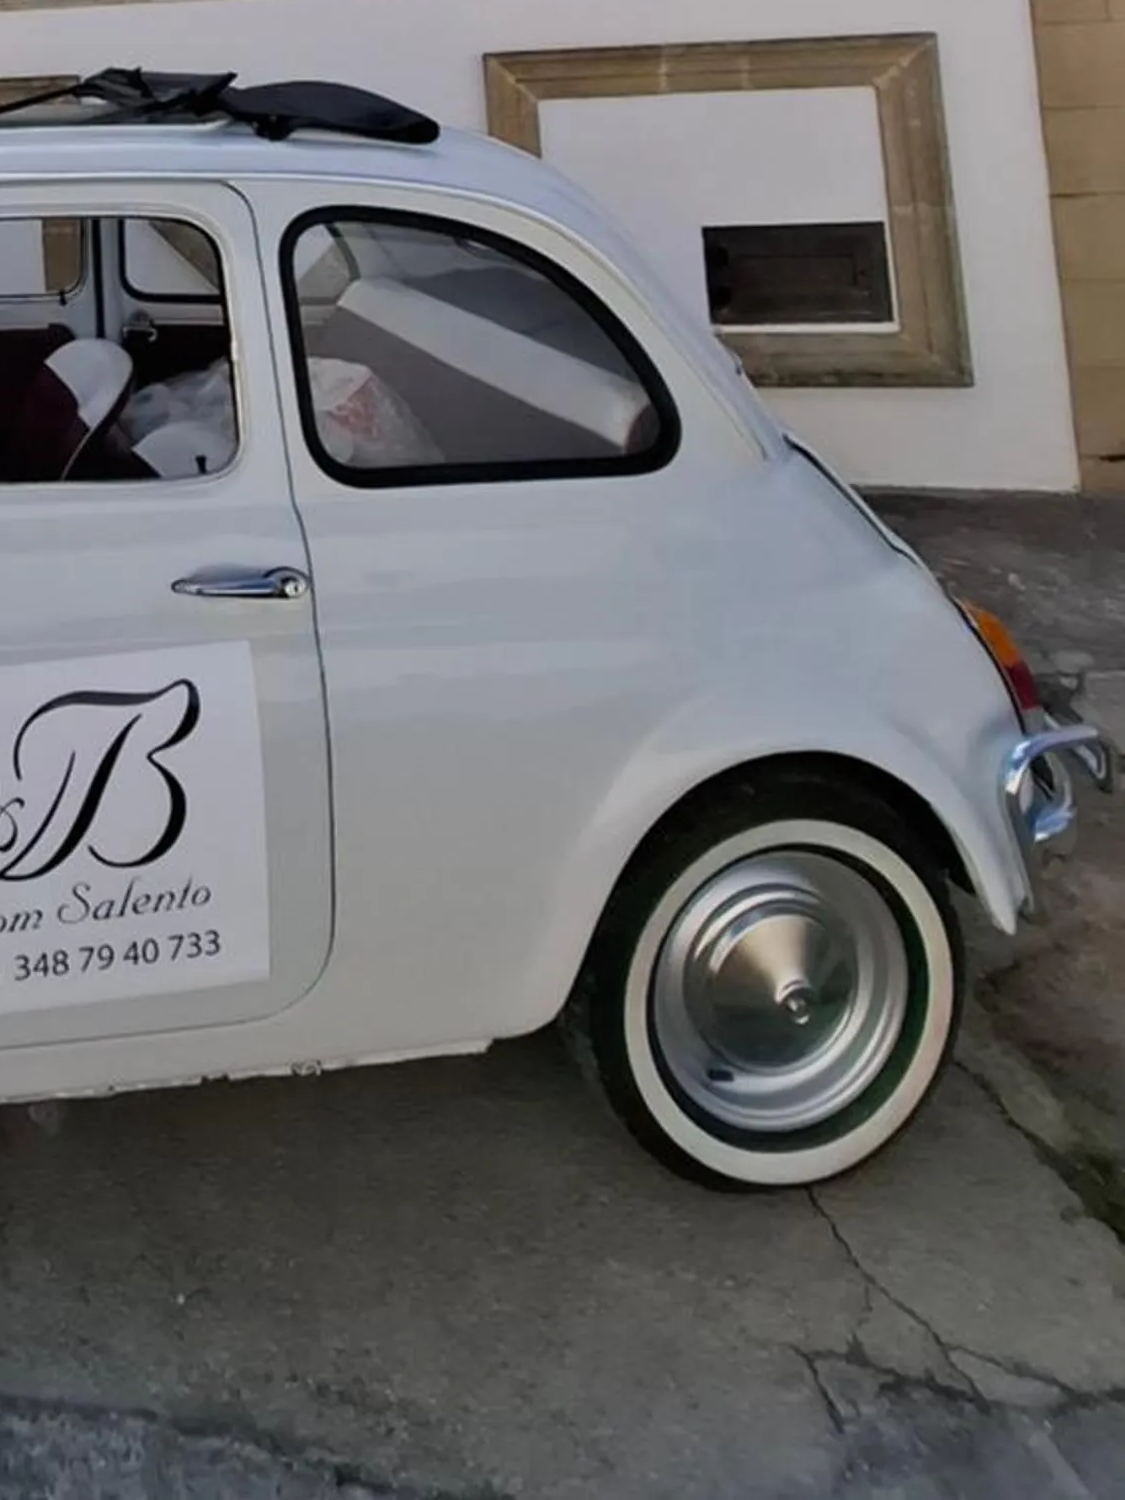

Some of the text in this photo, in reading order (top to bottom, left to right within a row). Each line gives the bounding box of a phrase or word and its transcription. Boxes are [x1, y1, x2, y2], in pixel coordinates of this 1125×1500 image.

[56, 874, 212, 925] Salento
[13, 949, 70, 982] 348
[78, 943, 116, 973] 79
[123, 937, 161, 966] 40
[167, 928, 222, 962] 733
